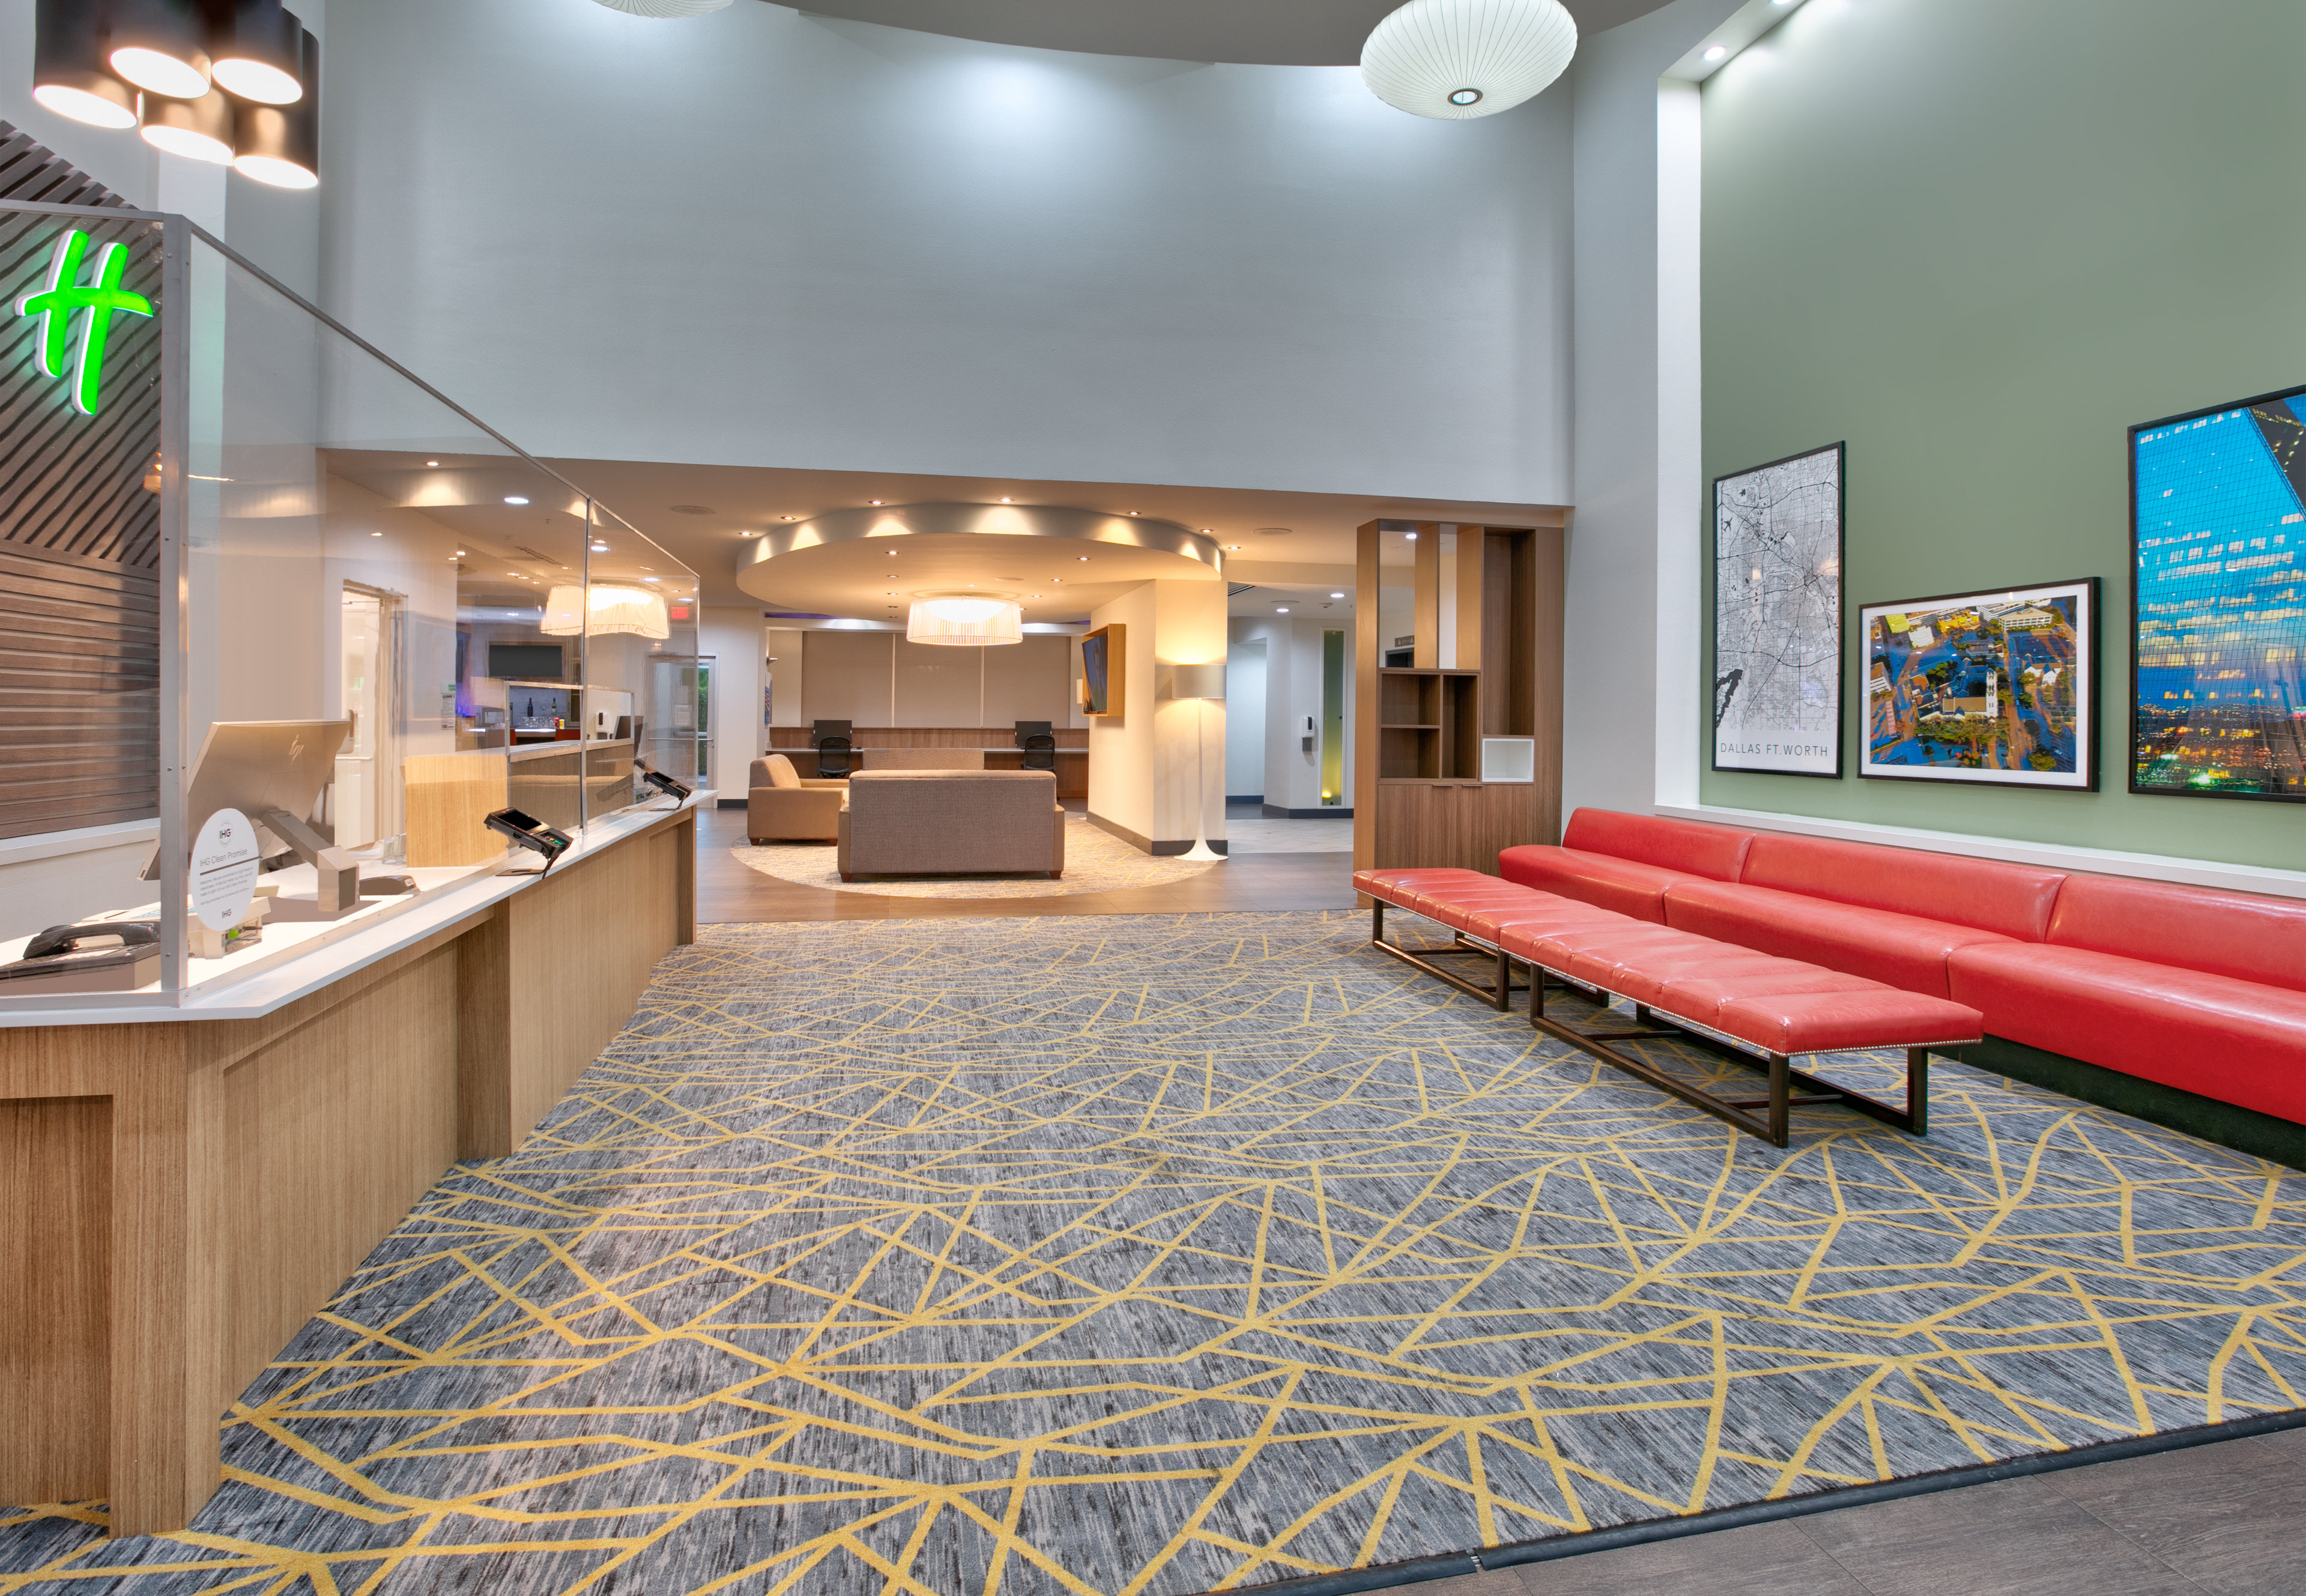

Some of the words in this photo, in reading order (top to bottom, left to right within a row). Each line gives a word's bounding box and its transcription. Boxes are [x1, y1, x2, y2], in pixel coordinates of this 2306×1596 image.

[1720, 743, 1761, 754] DALLAS
[1766, 744, 1827, 757] FT.WORTH
[219, 829, 231, 839] IHG
[200, 857, 210, 867] IHG
[211, 854, 227, 864] Clean
[228, 849, 247, 859] Promise
[222, 908, 232, 918] IHG
